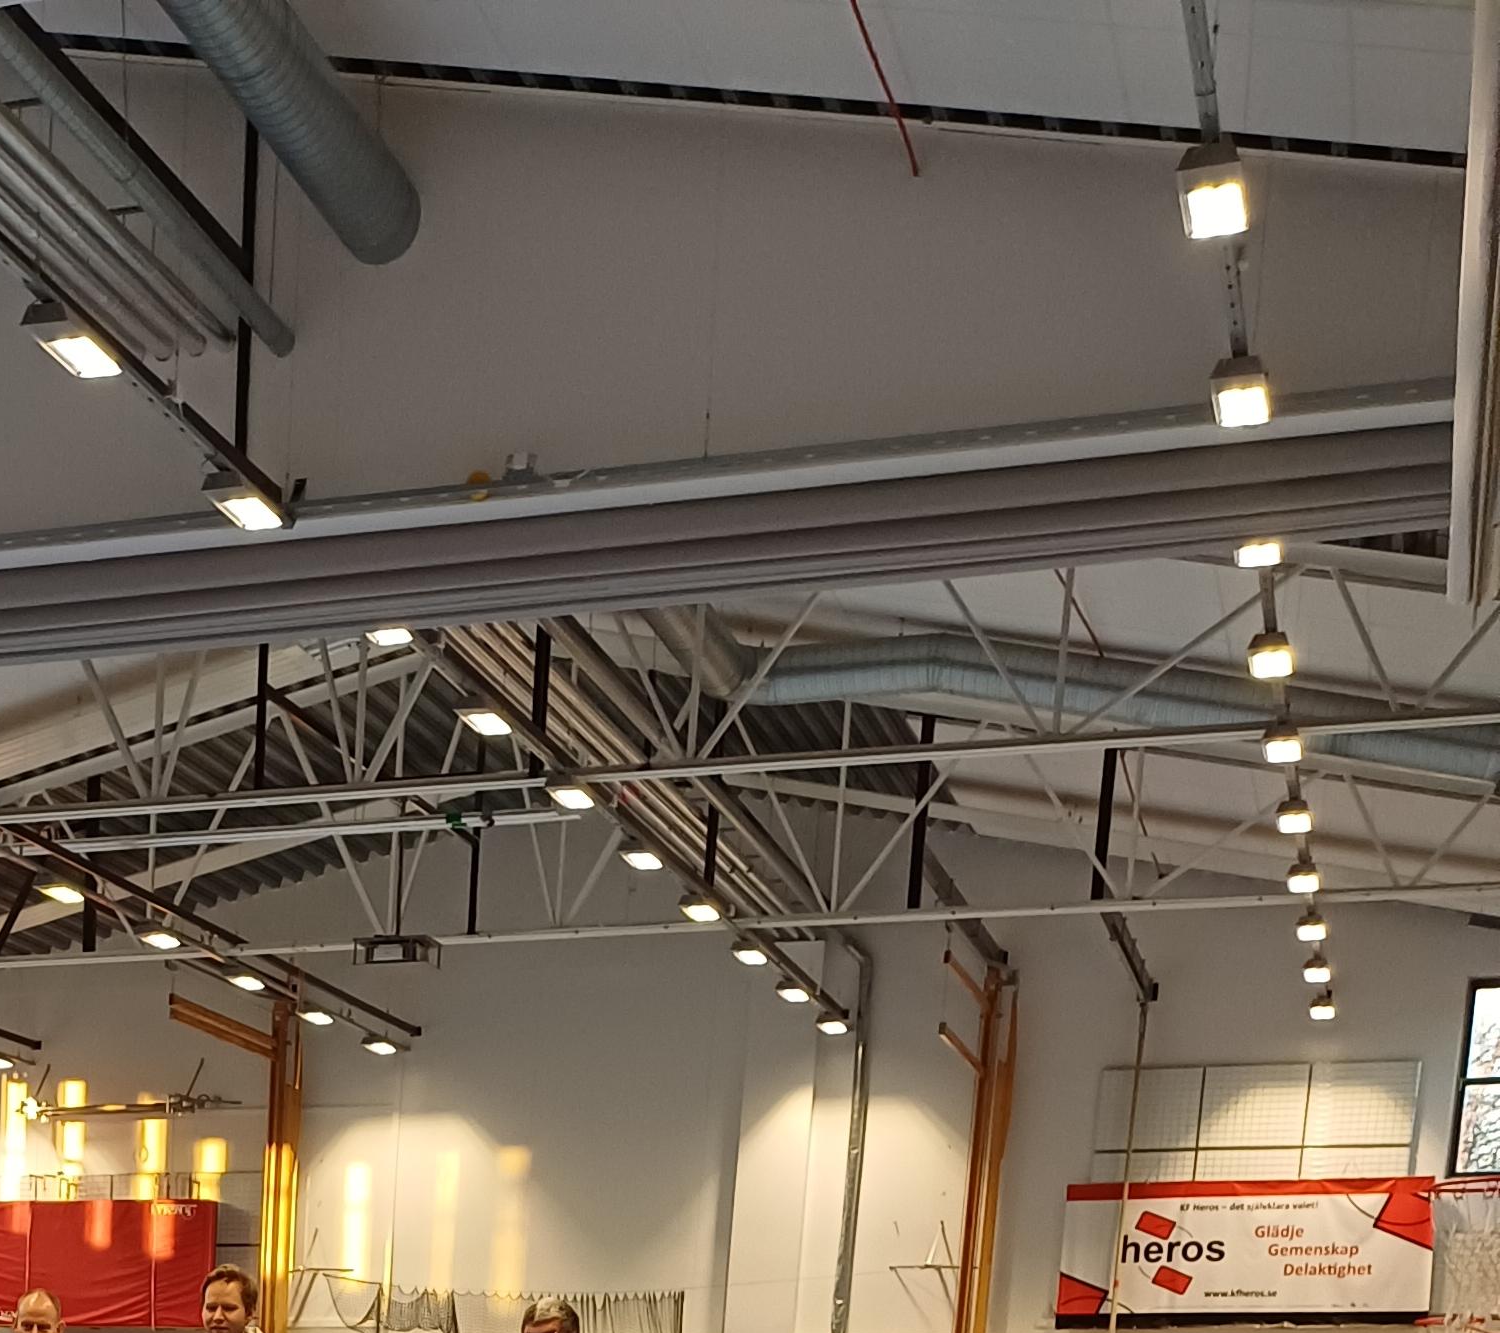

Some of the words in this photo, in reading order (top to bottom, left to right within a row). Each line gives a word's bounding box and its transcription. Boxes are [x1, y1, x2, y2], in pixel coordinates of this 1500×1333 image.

[1229, 1202, 1244, 1211] det
[1254, 1225, 1304, 1241] Glädje
[1121, 1234, 1226, 1263] heros
[1267, 1242, 1359, 1258] Gemenskap
[1283, 1262, 1372, 1278] Delaktighet
[1203, 1288, 1277, 1297] www.kfheros.se
